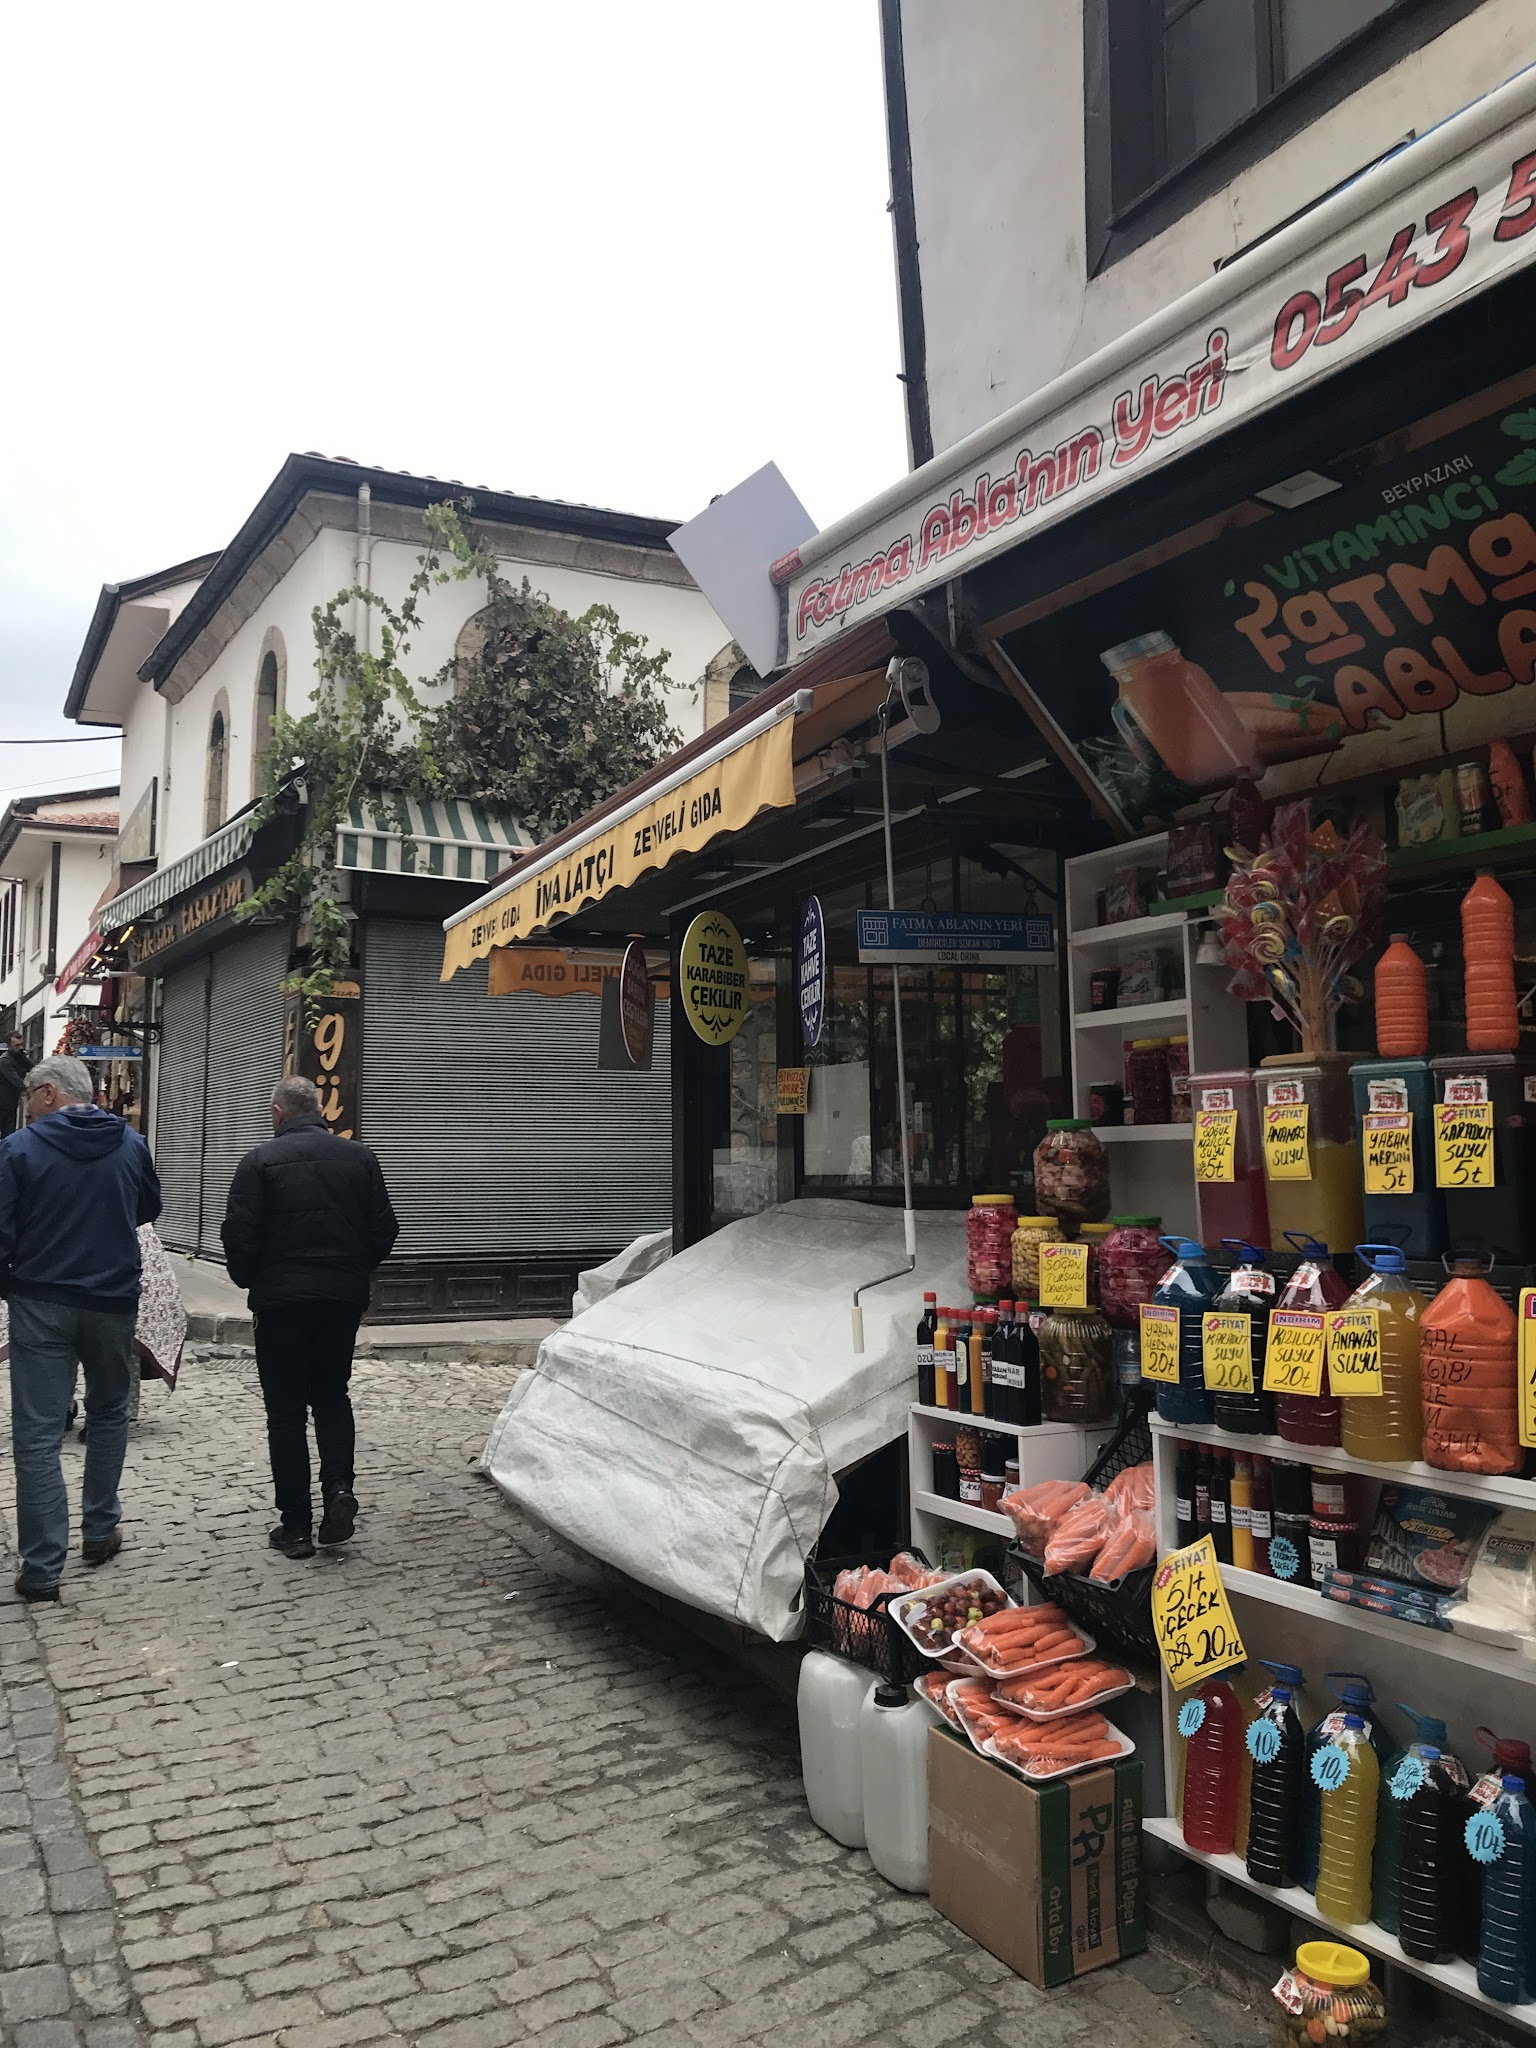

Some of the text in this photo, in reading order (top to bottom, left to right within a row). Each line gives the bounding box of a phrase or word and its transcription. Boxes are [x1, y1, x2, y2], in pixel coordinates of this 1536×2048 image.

[798, 534, 913, 640] Fatma
[1110, 328, 1229, 467] Yeri
[1271, 186, 1478, 370] 0543
[1381, 454, 1474, 504] BEYPAZARI
[691, 787, 722, 828] GIDA
[892, 917, 935, 930] FATMA
[995, 919, 1023, 932] YERİ
[699, 943, 734, 967] TAZE
[686, 966, 746, 989] KARABİBER
[690, 985, 742, 1011] ÇEKİLİR
[1457, 1107, 1487, 1119] FİYAT
[1266, 1126, 1305, 1143] ANANAS
[1369, 1131, 1409, 1149] YABAN
[1200, 1147, 1225, 1159] SUYU
[1272, 1147, 1304, 1166] SUYU
[1443, 1144, 1487, 1162] SUYU
[1043, 1257, 1082, 1272] SOĞAN
[1221, 1318, 1245, 1328] FİYAT
[1275, 1314, 1321, 1326] İNDİRİM
[1347, 1315, 1372, 1327] FİYAT
[1271, 1328, 1324, 1349] KIZILCIK
[1332, 1329, 1378, 1350] ANANAS
[1212, 1347, 1244, 1360] SUYU
[1275, 1349, 1315, 1364] SUYU
[1333, 1351, 1380, 1374] SUYU
[1173, 1546, 1208, 1574] FİYAT
[1160, 1589, 1220, 1641] İÇECEK
